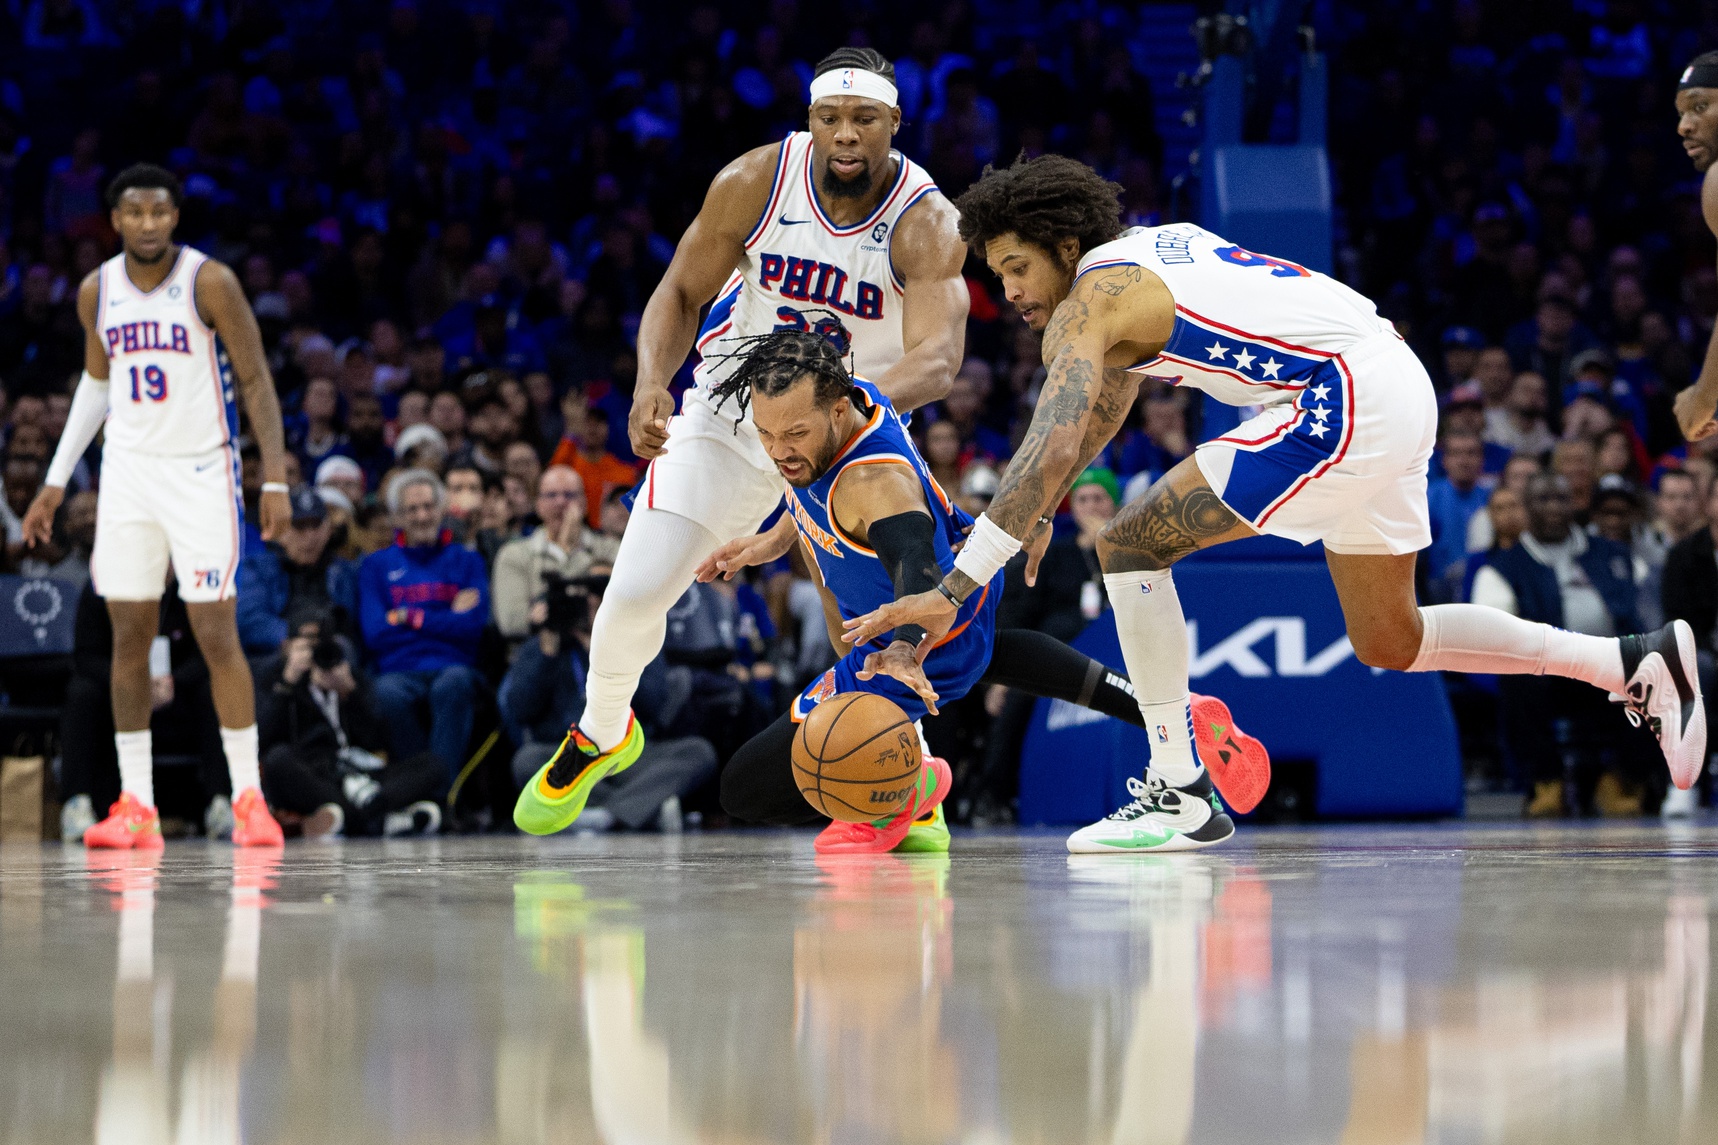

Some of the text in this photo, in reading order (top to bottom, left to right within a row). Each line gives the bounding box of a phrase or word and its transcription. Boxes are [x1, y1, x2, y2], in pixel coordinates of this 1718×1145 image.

[760, 252, 884, 320] PHILA
[105, 321, 193, 359] PHILA
[129, 365, 168, 404] 19
[194, 569, 220, 589] 76
